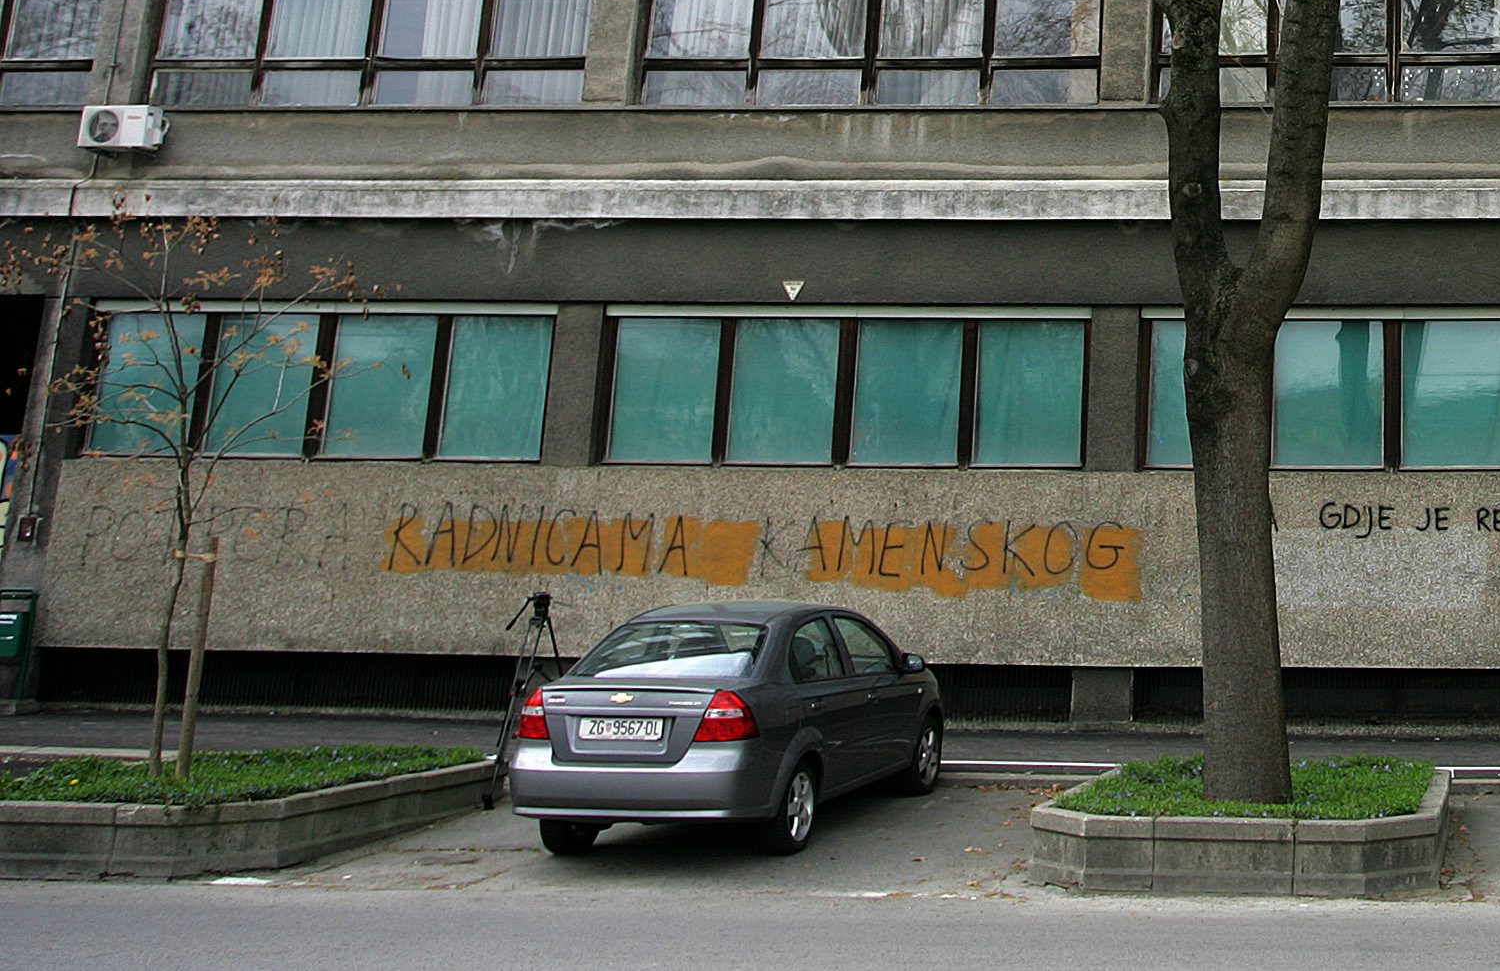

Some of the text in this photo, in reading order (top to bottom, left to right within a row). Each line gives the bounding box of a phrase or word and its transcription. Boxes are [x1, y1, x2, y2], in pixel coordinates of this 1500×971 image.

[1318, 501, 1396, 539] GDJE
[1415, 506, 1450, 532] JE
[387, 501, 688, 578] RADNICAMA
[760, 515, 1126, 578] KAMENSKOG
[589, 720, 605, 735] ZG
